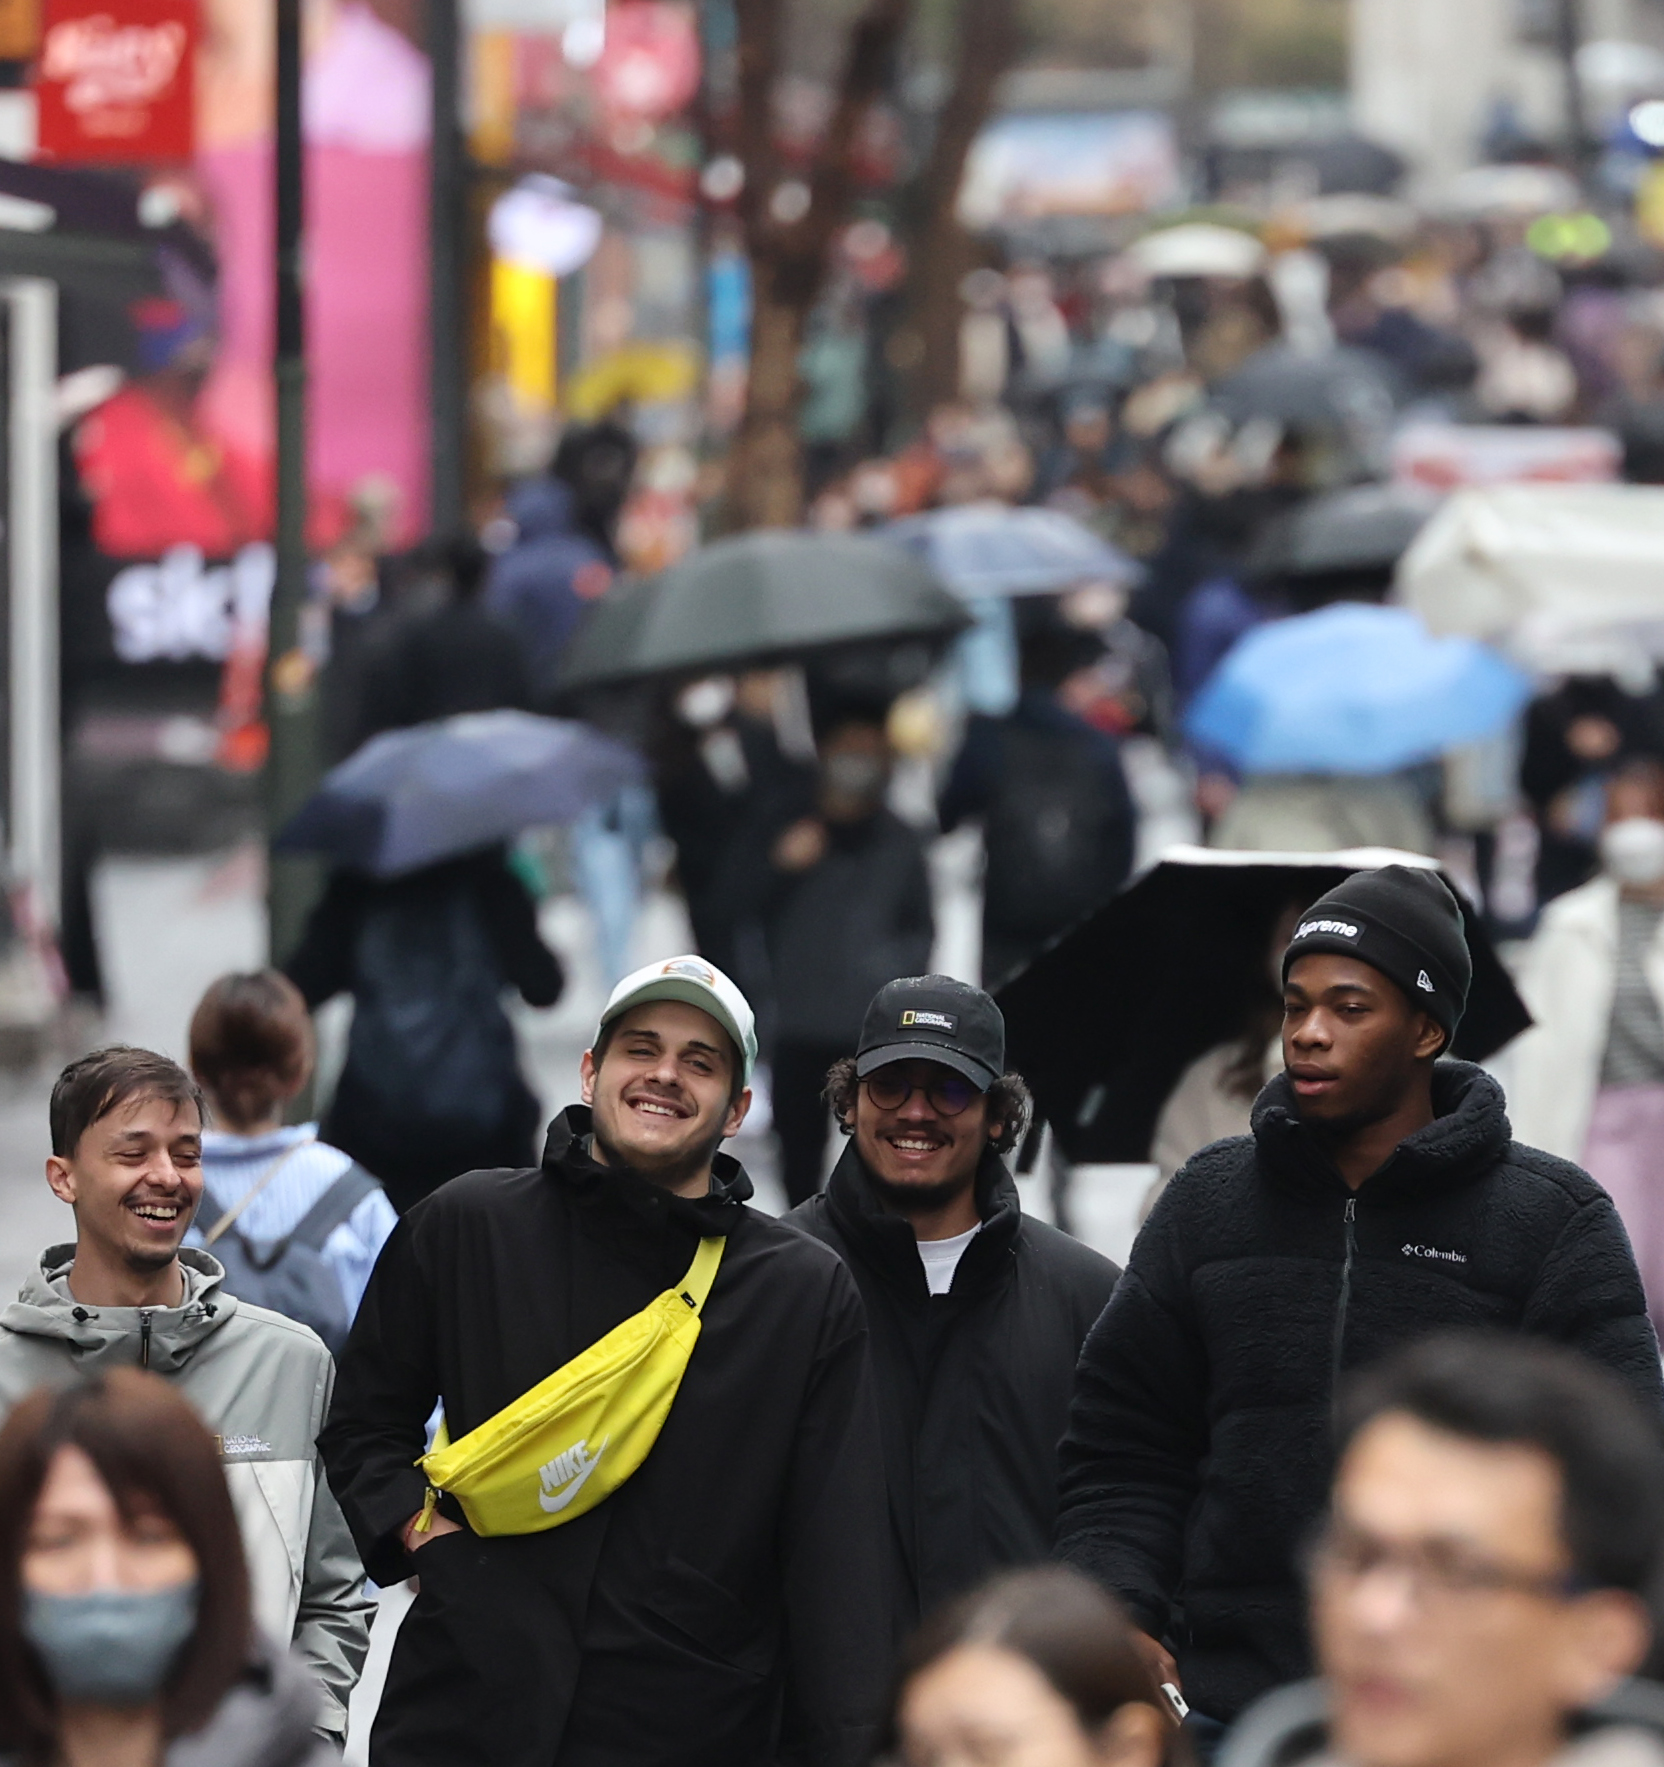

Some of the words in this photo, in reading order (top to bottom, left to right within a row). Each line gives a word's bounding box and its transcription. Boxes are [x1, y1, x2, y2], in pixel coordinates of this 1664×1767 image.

[1414, 1245, 1467, 1263] Columbia
[224, 1435, 261, 1445] NATIONAL
[224, 1442, 271, 1454] GEOGRAPHIC
[539, 1439, 593, 1492] NIKE
